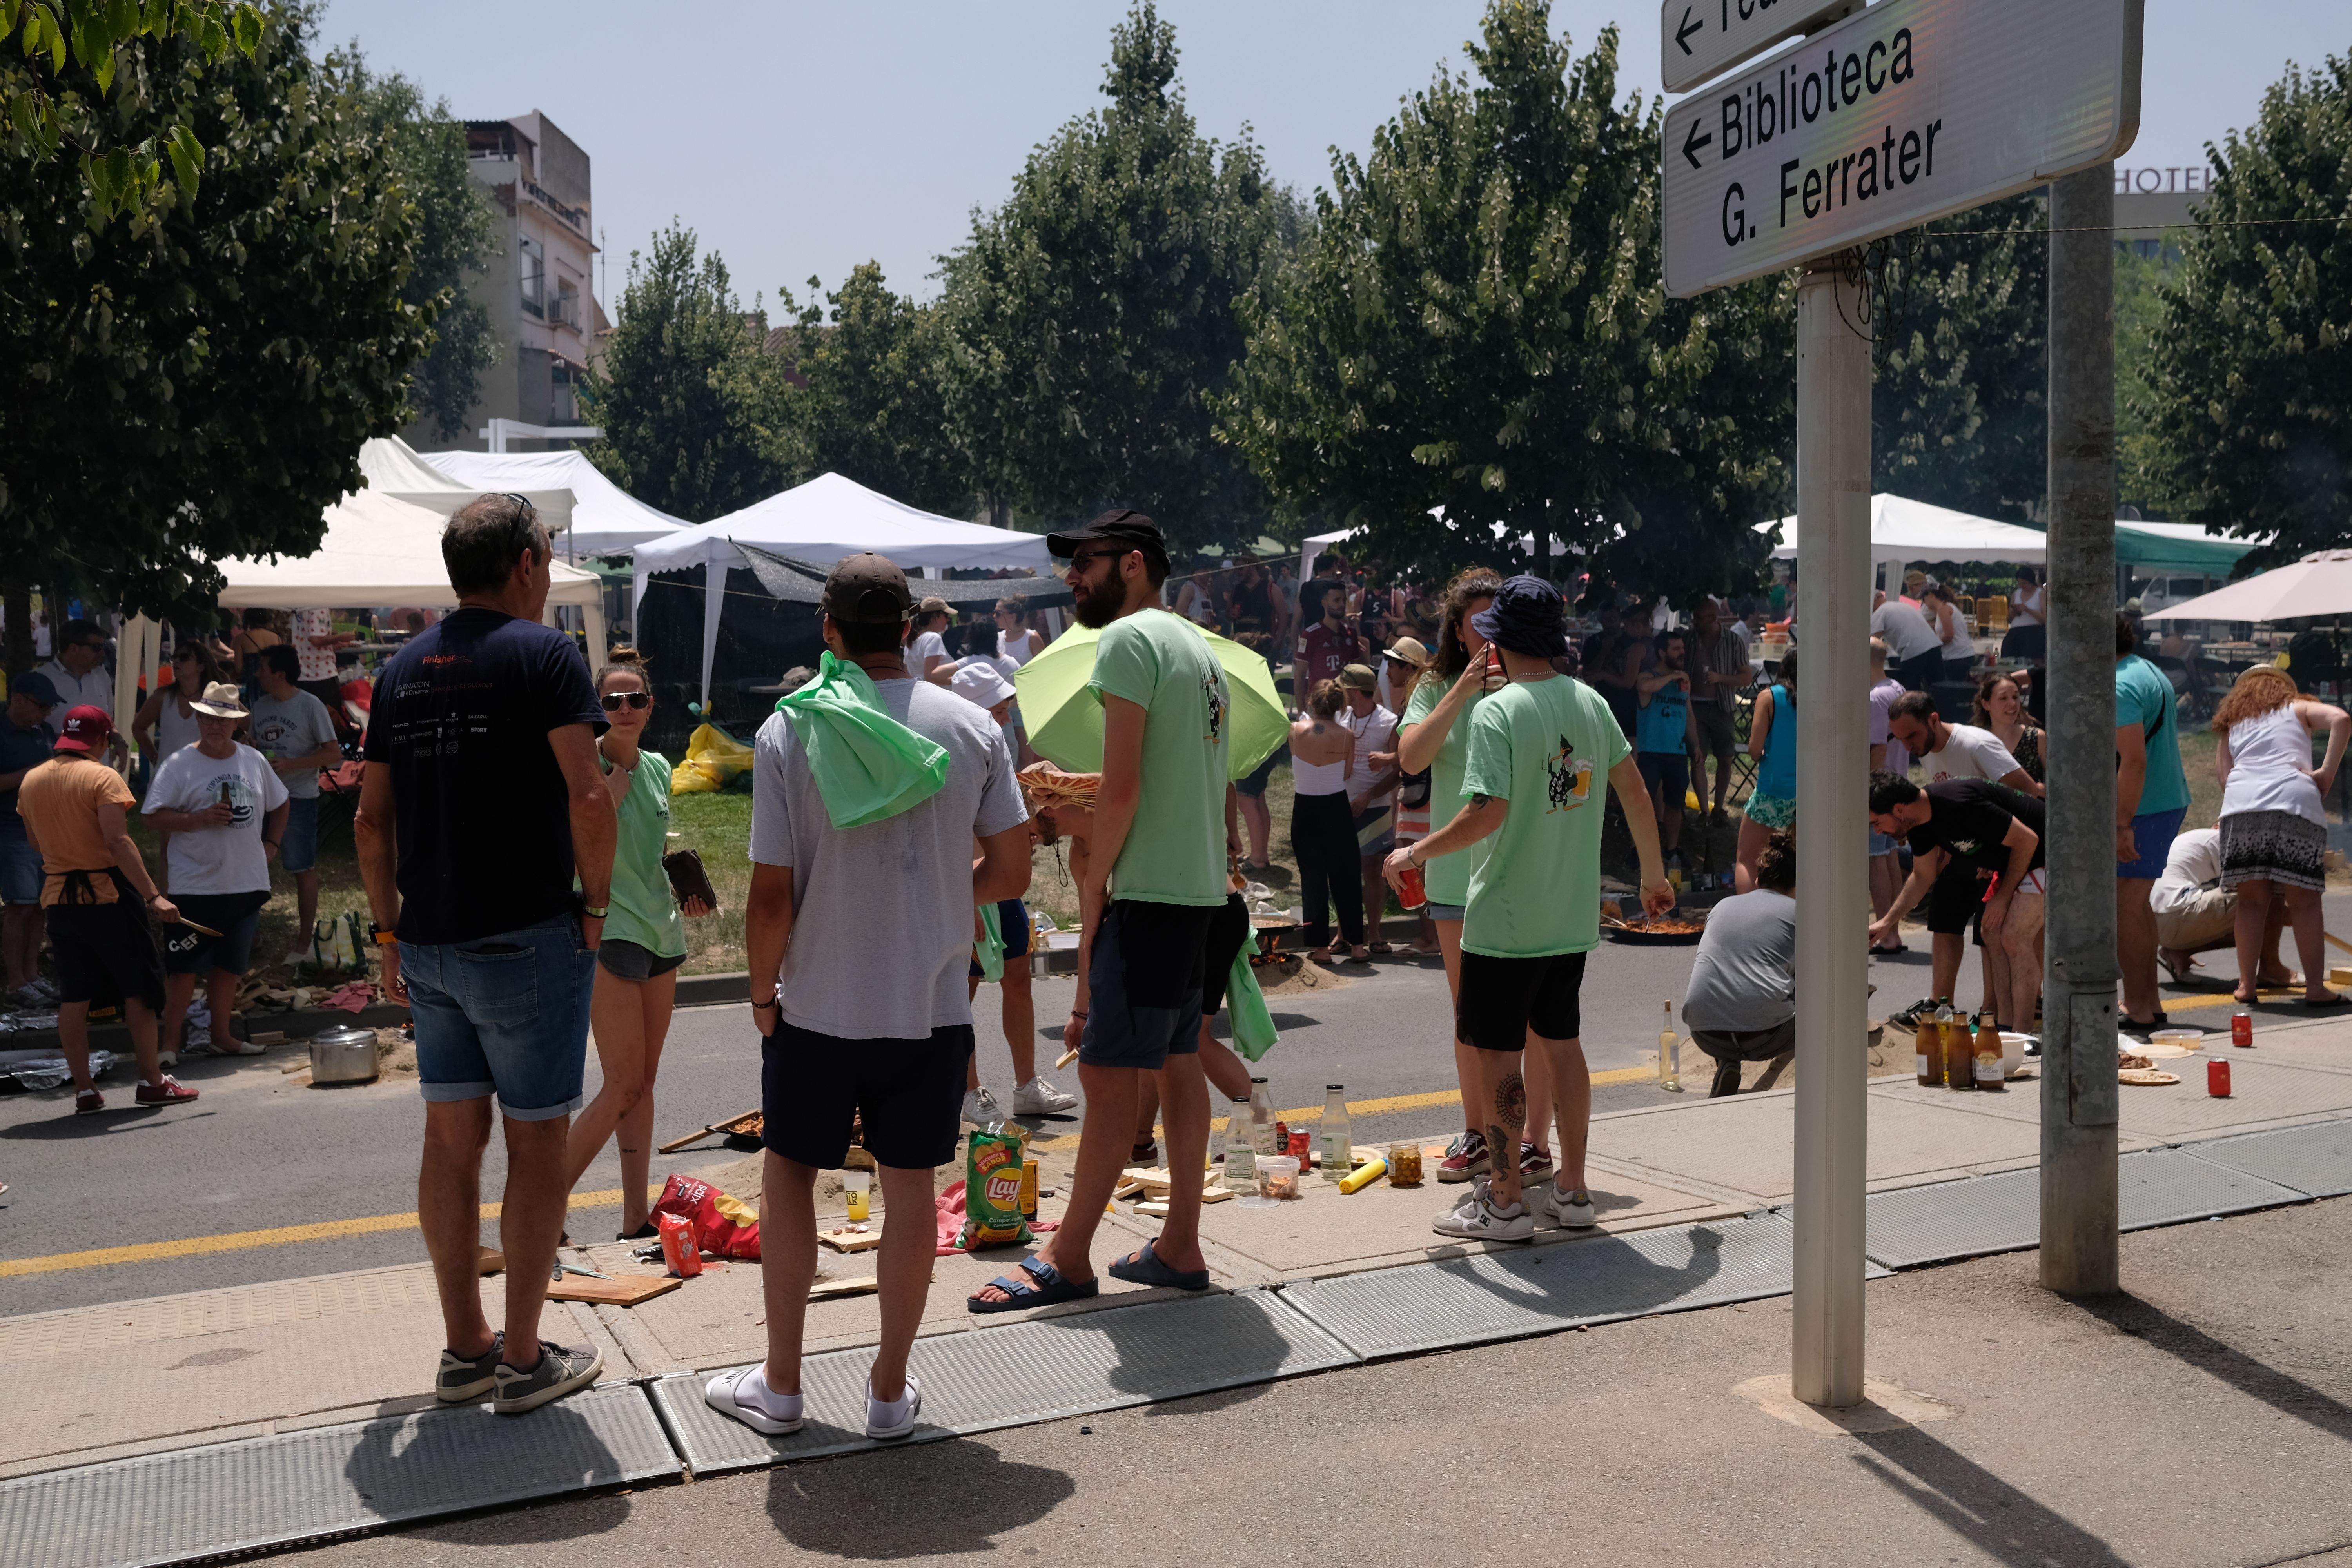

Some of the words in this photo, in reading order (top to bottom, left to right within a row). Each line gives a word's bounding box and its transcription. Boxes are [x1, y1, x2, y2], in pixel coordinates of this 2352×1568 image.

[1722, 28, 1914, 160] Biblioteca
[1722, 182, 1755, 246] G.
[1780, 119, 1941, 228] Ferrater
[2114, 168, 2216, 193] HOTEL
[1372, 601, 1380, 613] 5
[423, 655, 455, 664] Finisher
[207, 773, 232, 792] TOPANGA
[169, 932, 198, 952] CEF
[978, 1153, 999, 1167] DESCUBRE
[982, 1156, 1006, 1171] SABOR
[690, 1185, 708, 1205] xips
[989, 1178, 1020, 1202] Lay
